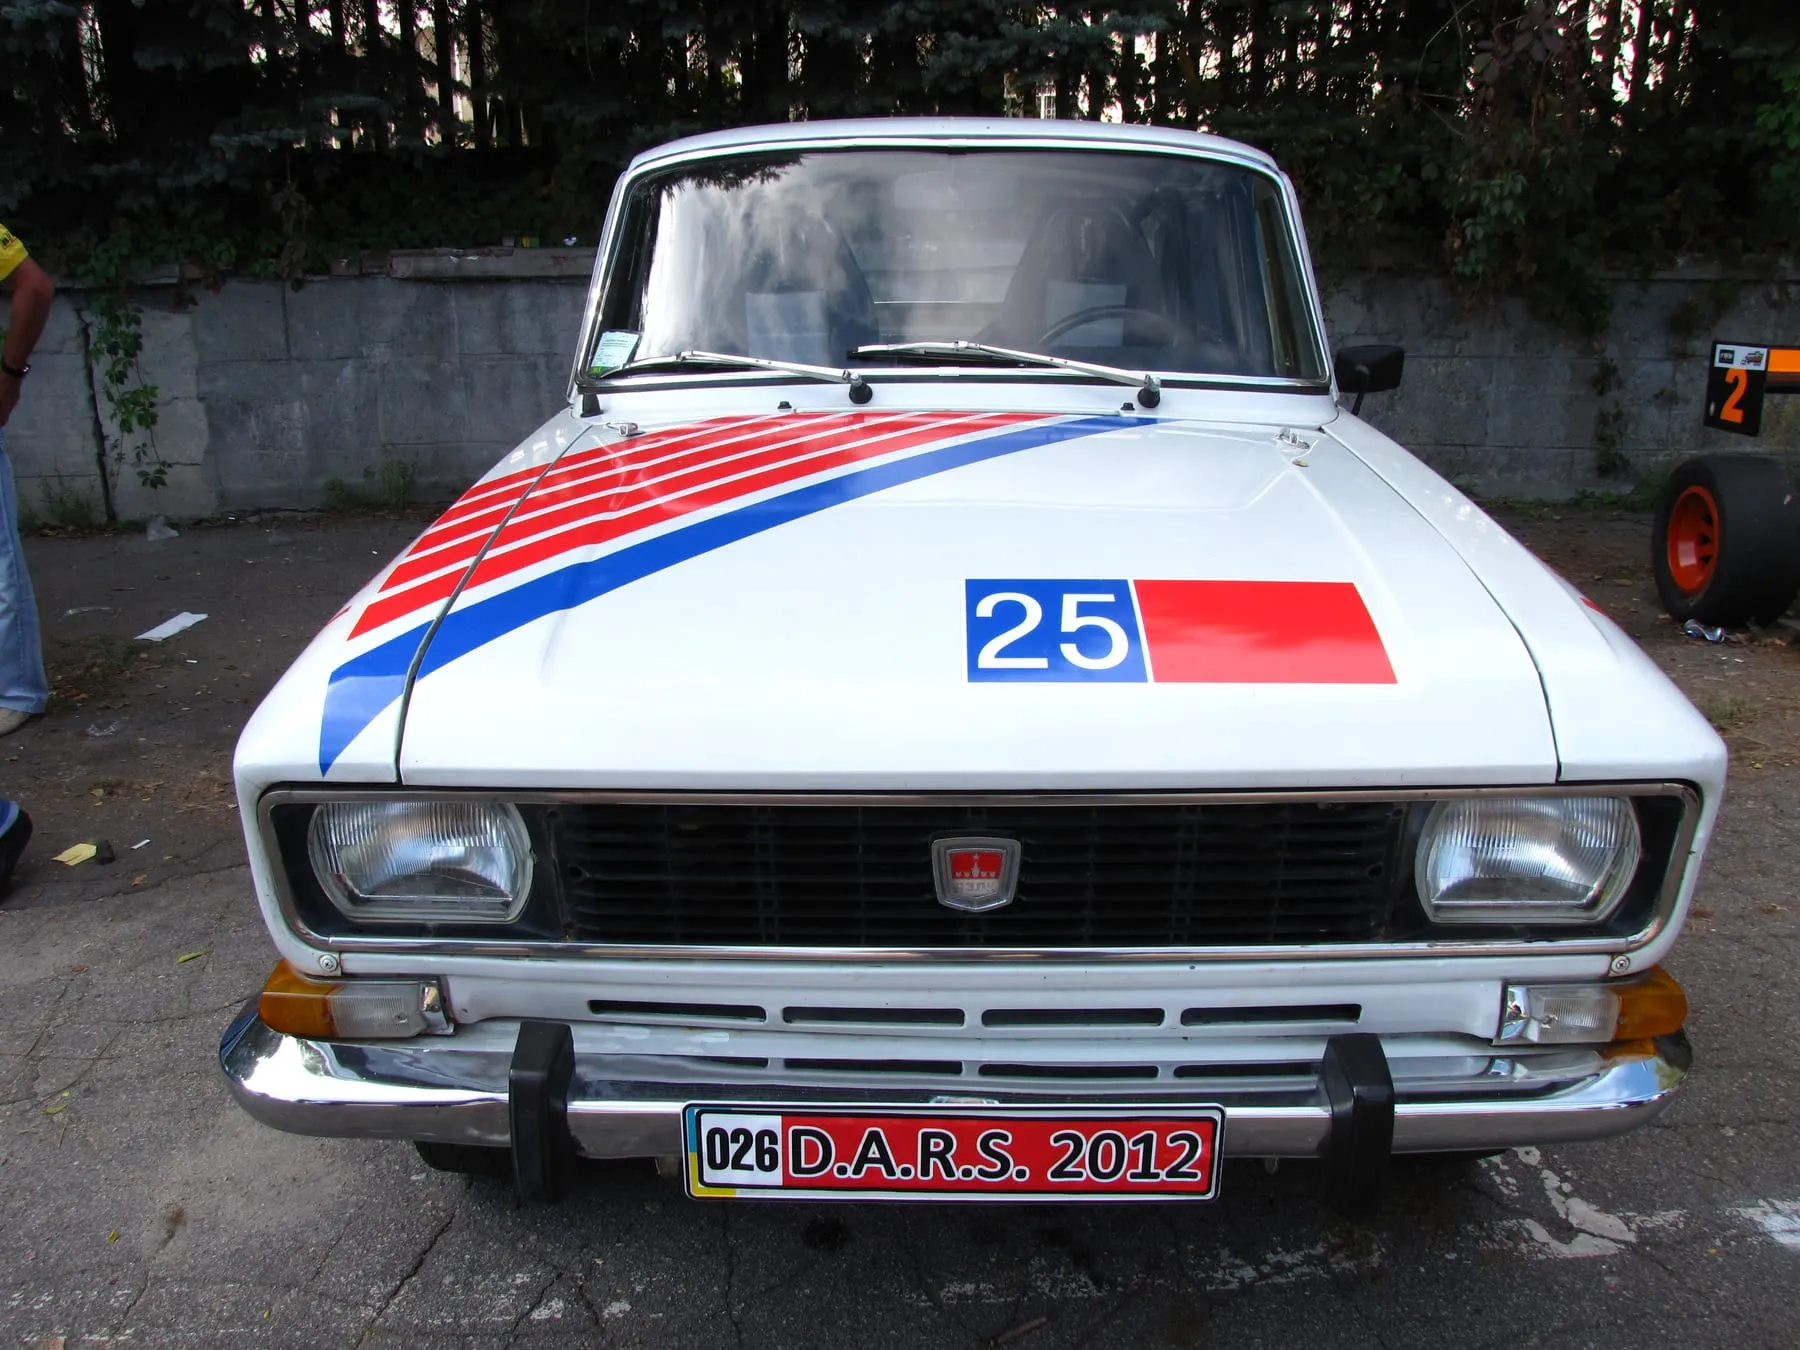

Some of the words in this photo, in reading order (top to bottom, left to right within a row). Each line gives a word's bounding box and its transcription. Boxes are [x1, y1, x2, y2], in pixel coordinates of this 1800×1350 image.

[1720, 368, 1747, 423] 2
[975, 592, 1128, 669] 25
[706, 1127, 779, 1173] 026
[787, 1126, 1030, 1180] D.A.R.S.
[1047, 1129, 1202, 1182] 2012
